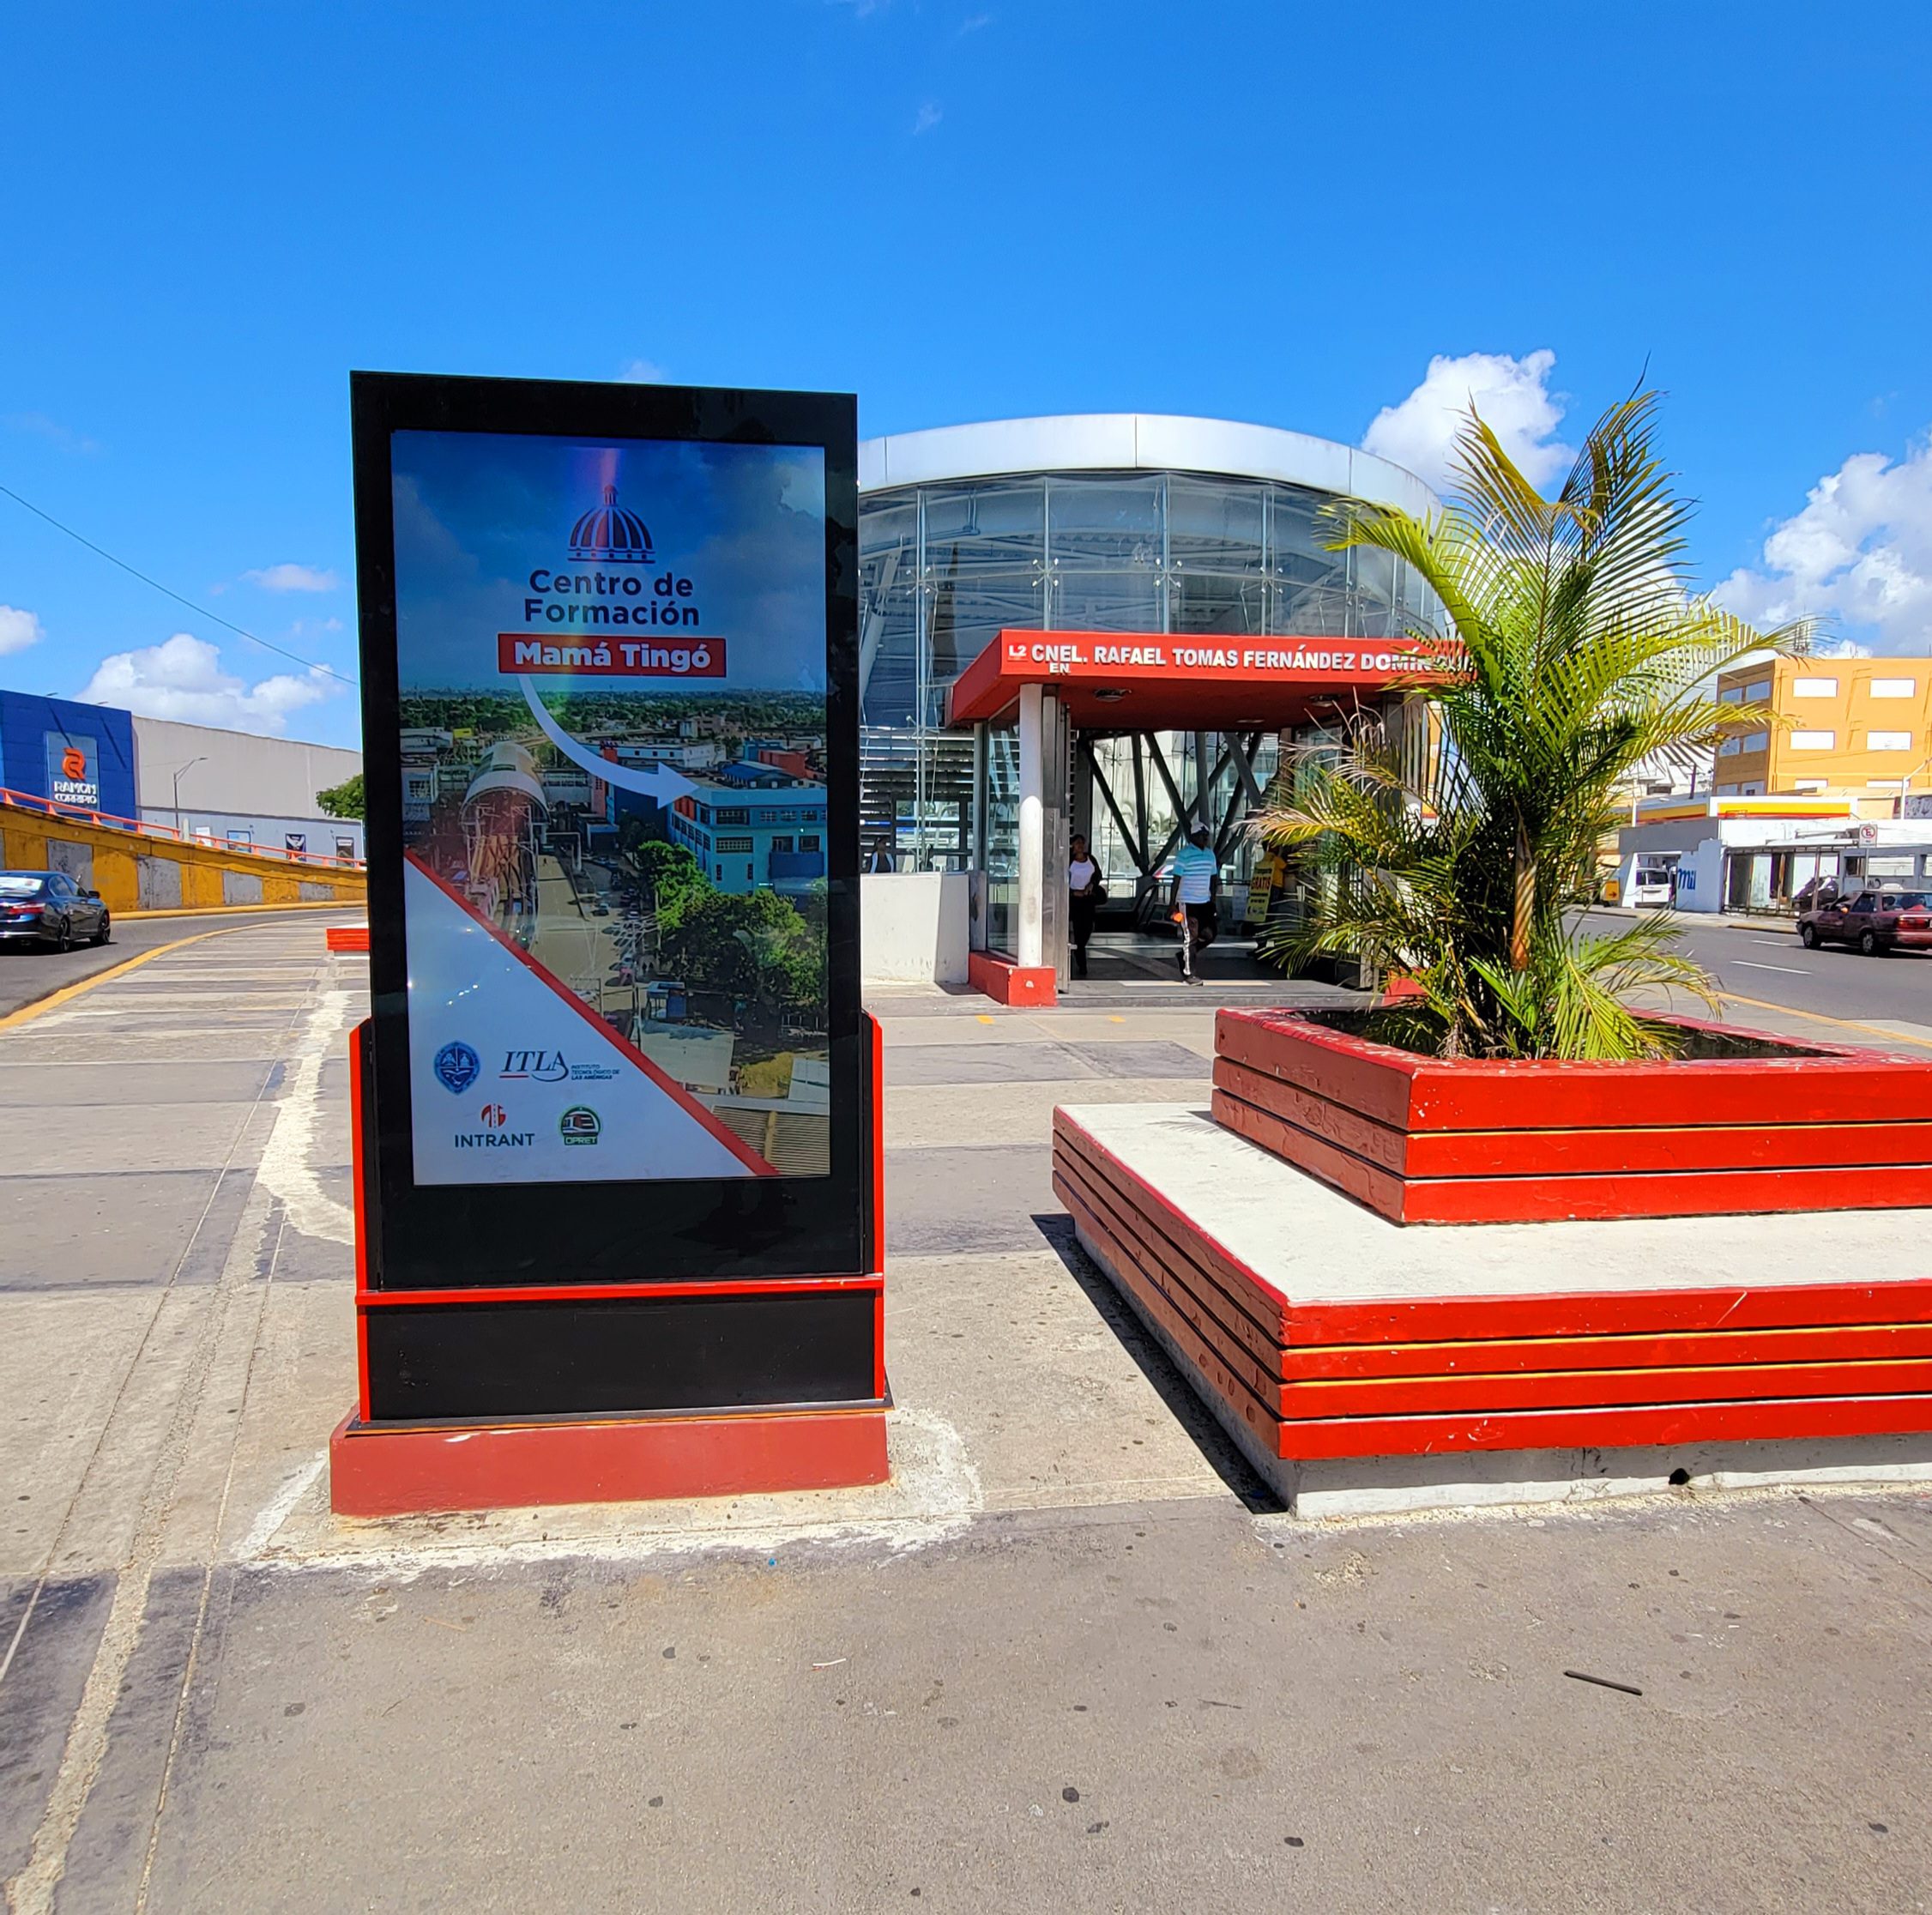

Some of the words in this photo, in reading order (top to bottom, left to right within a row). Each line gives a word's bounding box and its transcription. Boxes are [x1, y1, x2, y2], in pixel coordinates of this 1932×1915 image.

[529, 569, 642, 595] Centro
[654, 572, 693, 597] de
[524, 598, 699, 626] Formación
[515, 641, 612, 667] Mamá
[619, 643, 711, 673] Tingó
[1008, 644, 1027, 657] L2
[1031, 643, 1089, 663] CNEL.
[1094, 645, 1167, 666] RAFAEL
[1172, 648, 1238, 668] TOMAS
[1243, 643, 1355, 670] FERNÁNDEZ
[501, 1049, 569, 1078] ITLA
[455, 1133, 535, 1148] INTRANT
[565, 1136, 597, 1145] OPRET
